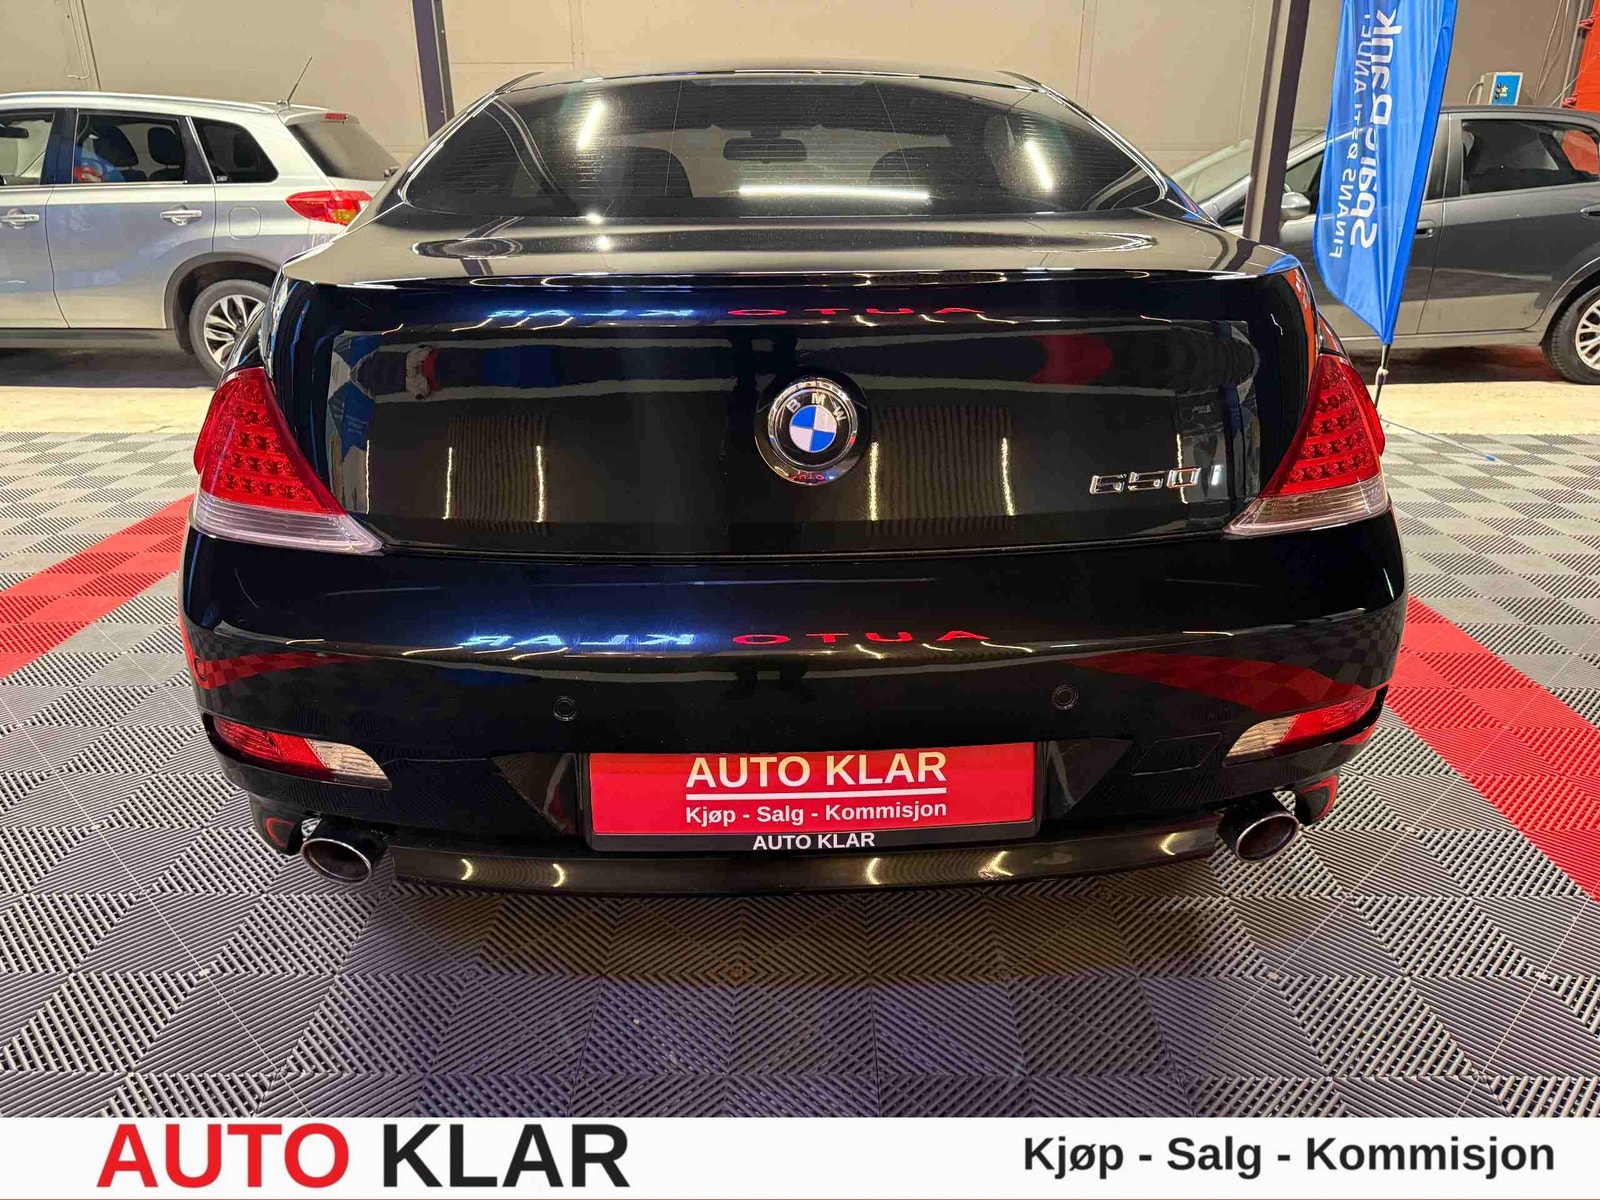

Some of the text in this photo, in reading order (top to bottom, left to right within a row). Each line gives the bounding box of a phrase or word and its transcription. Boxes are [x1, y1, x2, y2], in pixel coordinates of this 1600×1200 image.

[786, 391, 848, 423] BMW
[686, 751, 948, 788] AUTO KLAR
[685, 805, 737, 827] Kjøp
[756, 803, 804, 827] Salg
[825, 800, 948, 823] Kommisjon
[752, 831, 876, 851] AUTO KLAR
